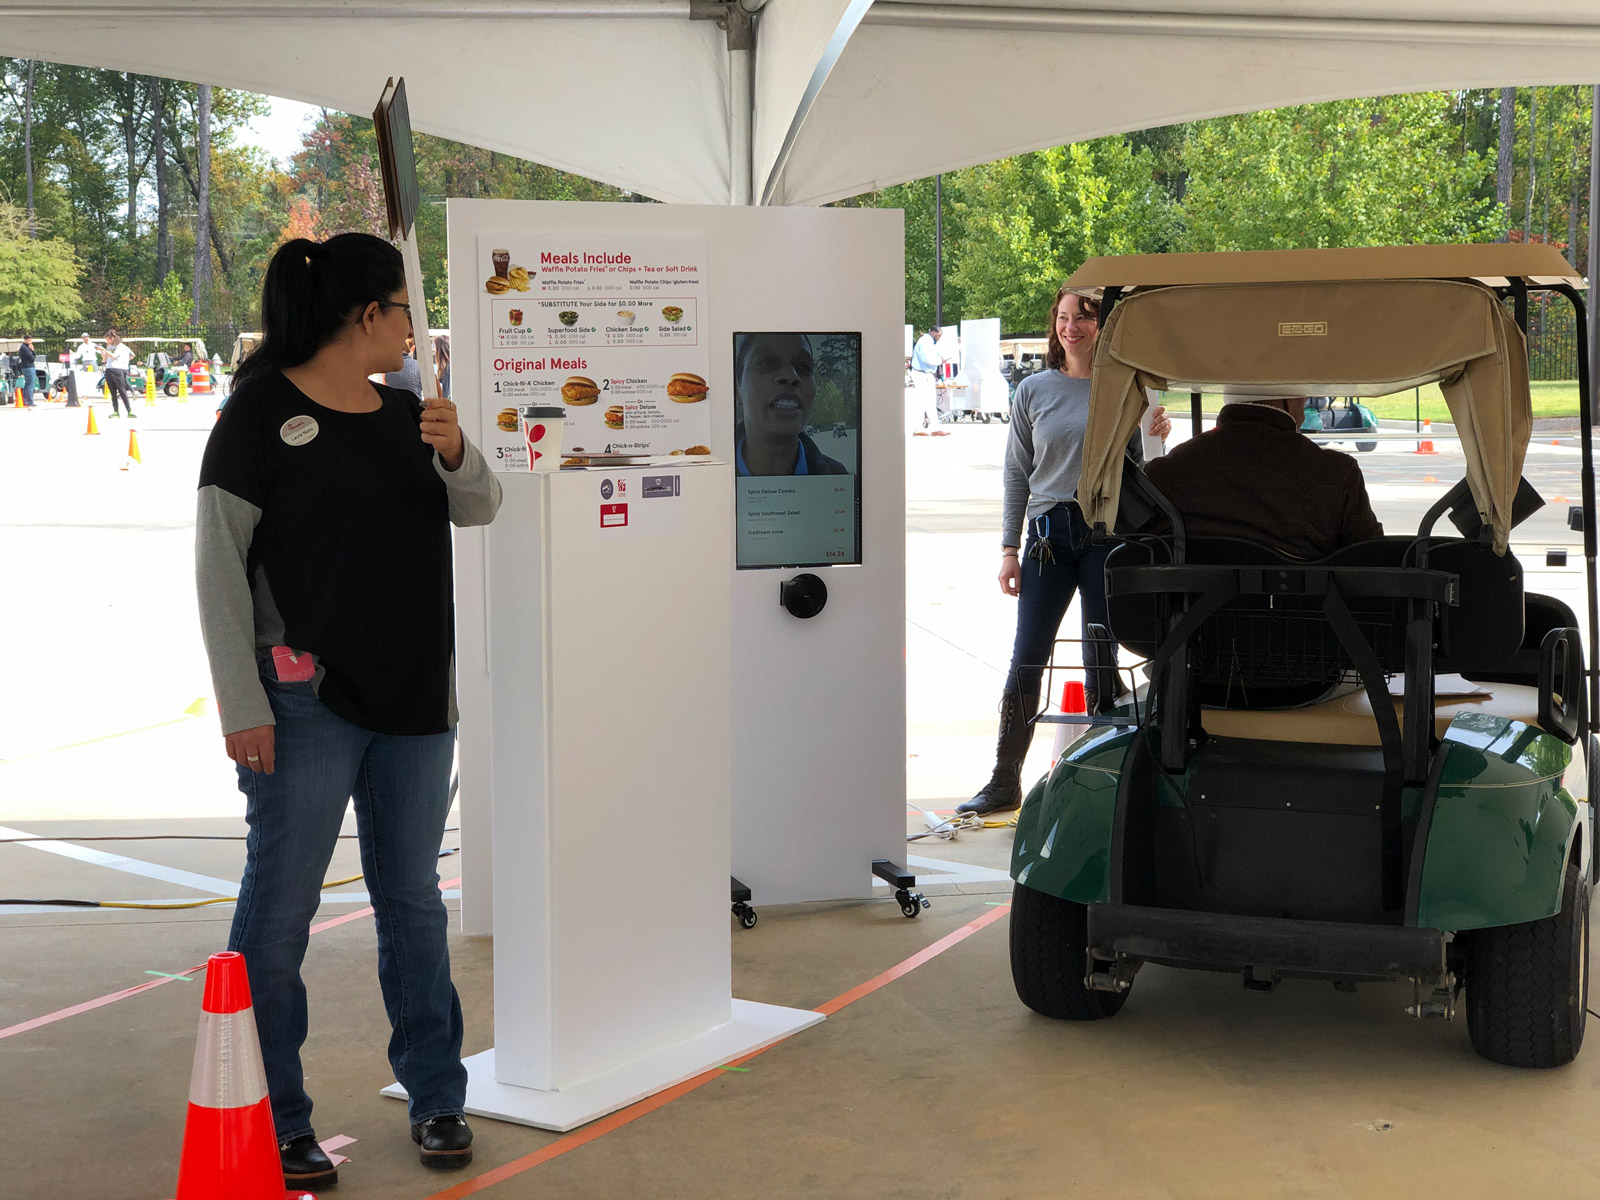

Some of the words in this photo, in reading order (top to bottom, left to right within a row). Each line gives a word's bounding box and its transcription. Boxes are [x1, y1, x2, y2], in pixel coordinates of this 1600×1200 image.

[541, 252, 579, 264] Meals
[583, 252, 631, 264] Include
[618, 266, 636, 274] Chips
[548, 327, 577, 335] Superfood
[494, 358, 545, 374] Original
[550, 357, 587, 369] Meals
[494, 382, 502, 393] 1
[603, 379, 610, 390] 2
[496, 447, 504, 459] 3
[604, 444, 612, 453] 4
